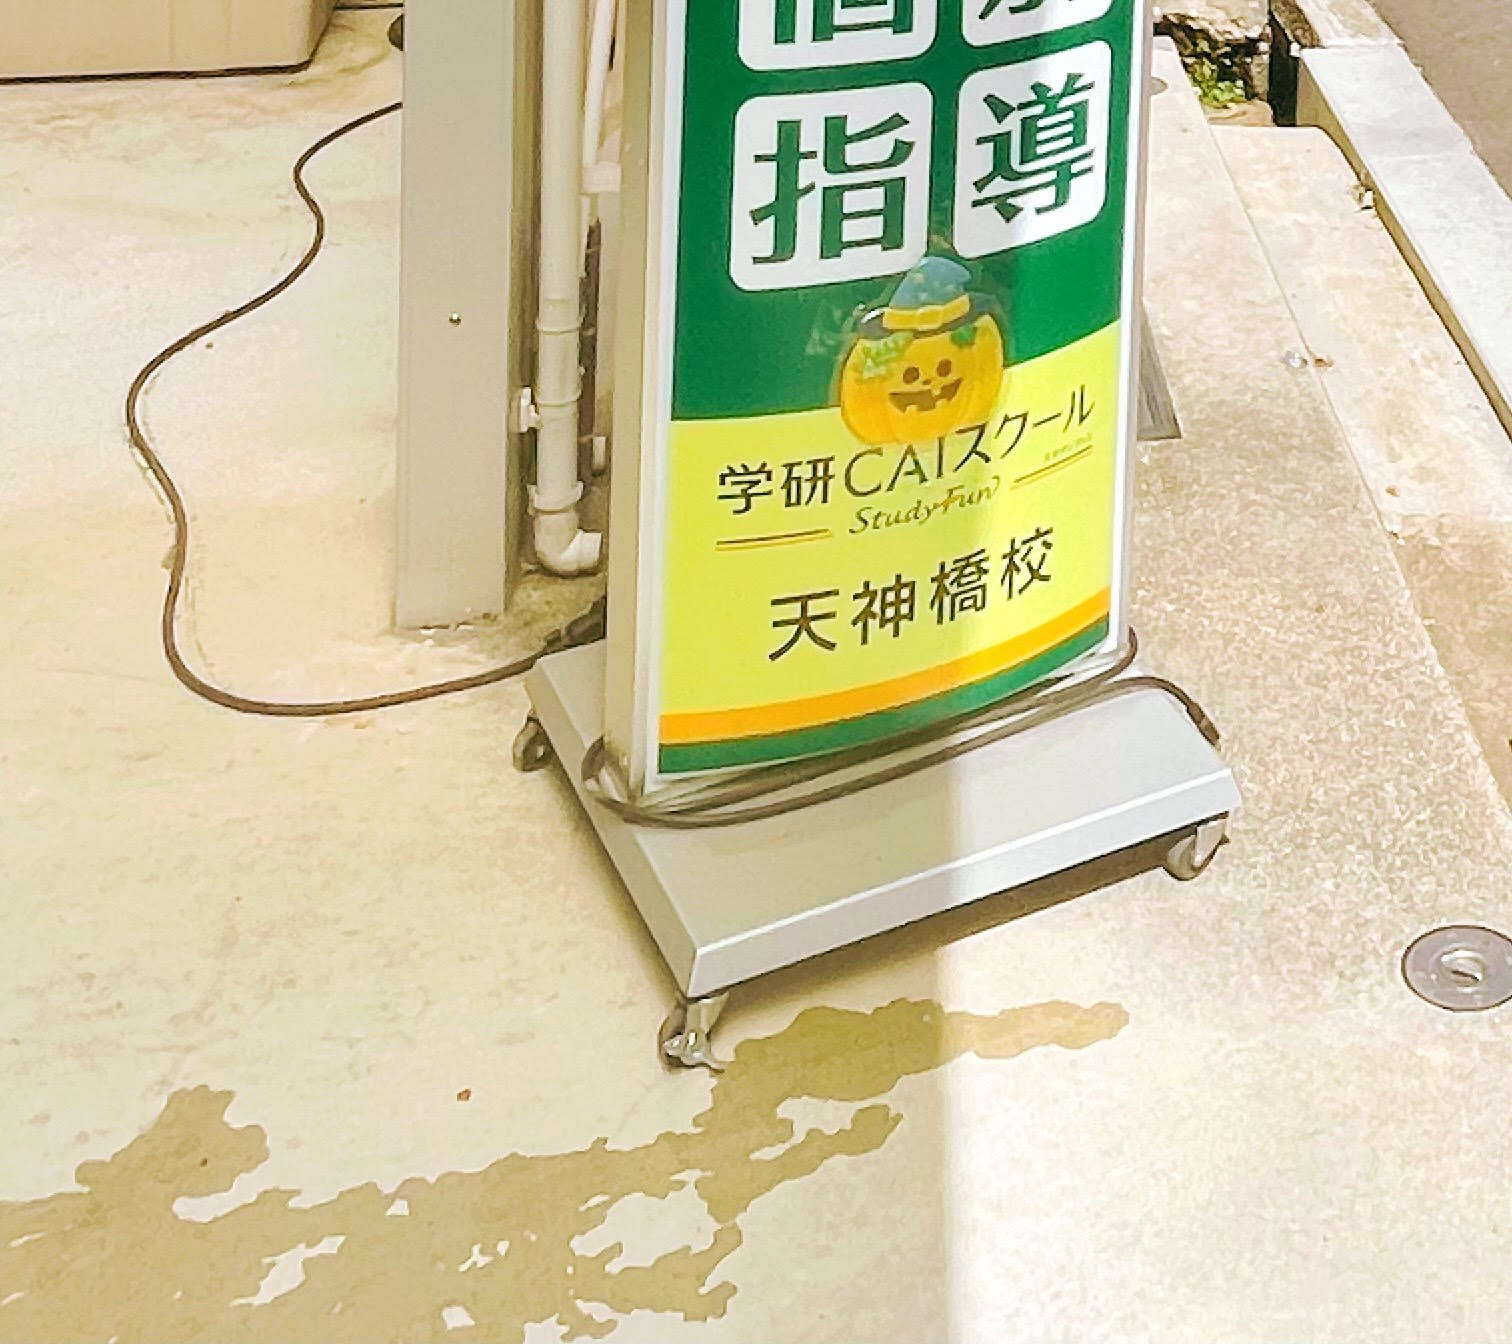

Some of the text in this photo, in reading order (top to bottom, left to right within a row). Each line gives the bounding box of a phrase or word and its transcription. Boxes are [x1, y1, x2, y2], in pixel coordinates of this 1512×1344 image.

[748, 72, 1097, 265] 指導
[716, 383, 1096, 515] 学研CAIスクール
[768, 526, 1054, 662] 天神橋校
